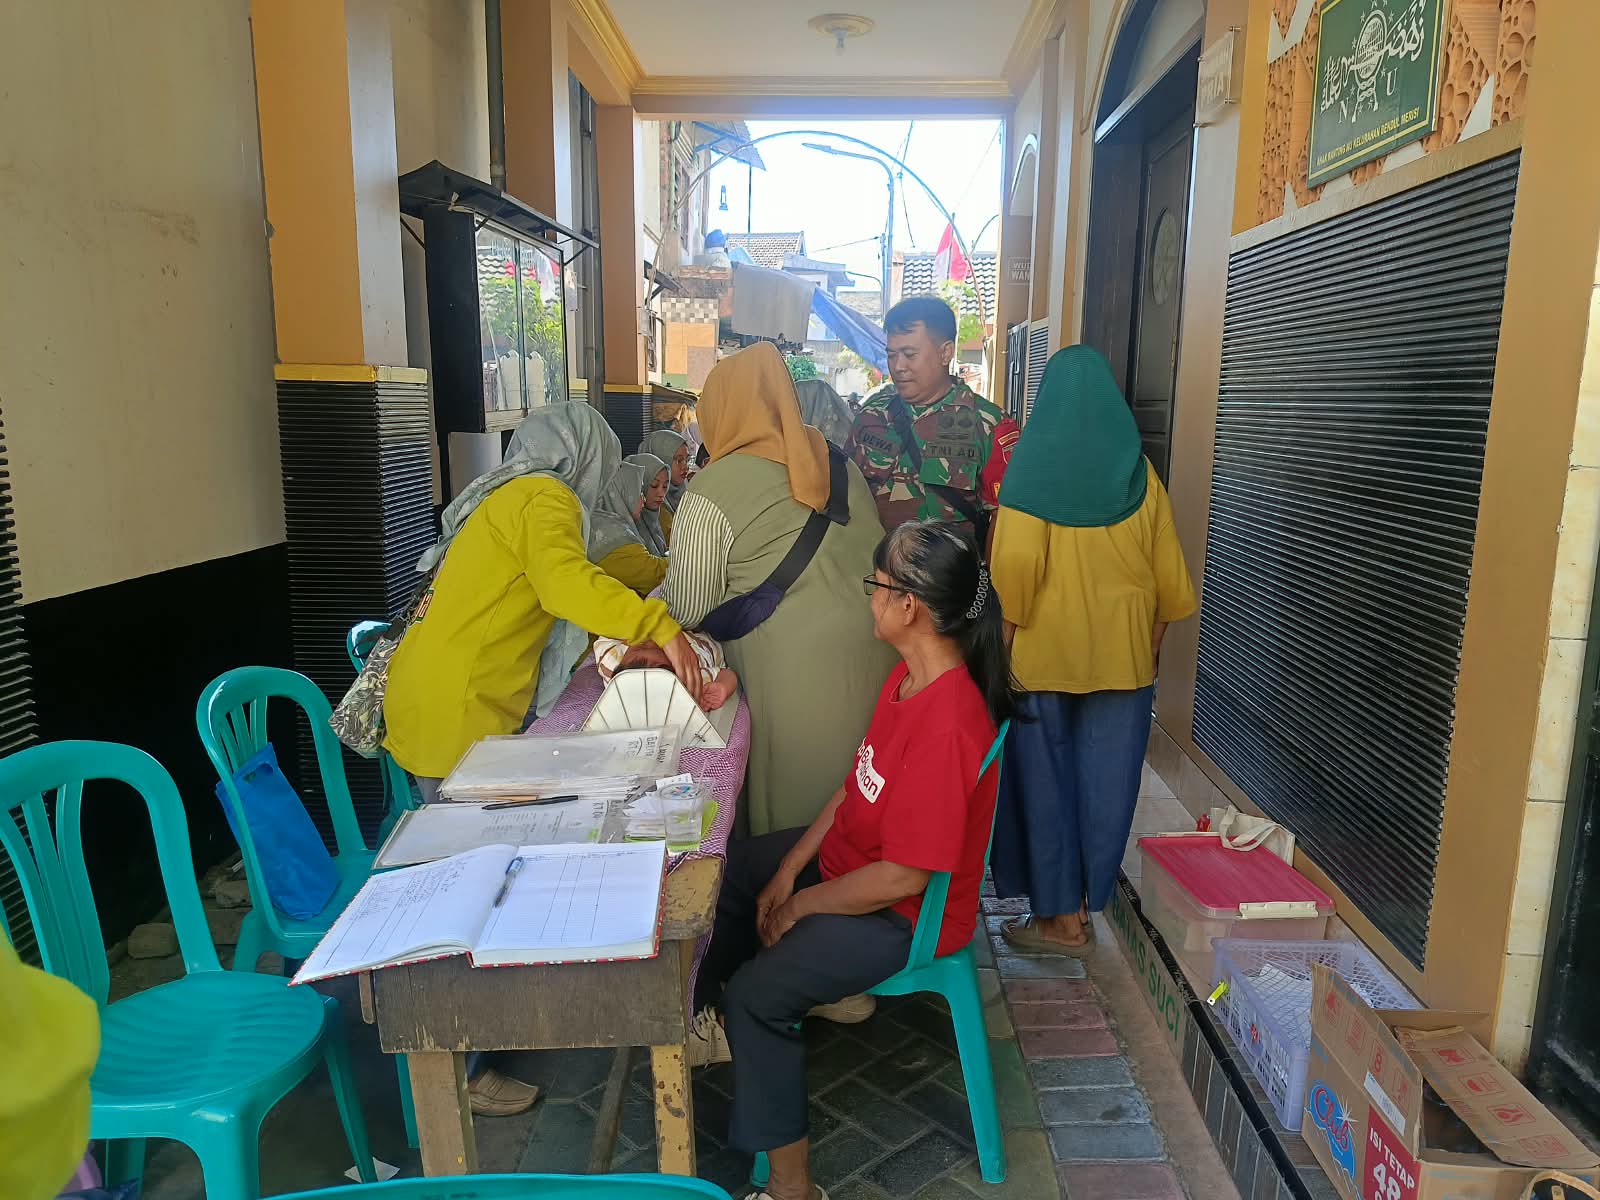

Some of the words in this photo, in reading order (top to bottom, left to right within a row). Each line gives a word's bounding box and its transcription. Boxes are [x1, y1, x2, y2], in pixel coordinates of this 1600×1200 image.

[1386, 67, 1398, 96] U
[931, 444, 952, 456] TNI
[1149, 961, 1181, 1041] SUCI
[1370, 1127, 1382, 1152] ISI
[1384, 1145, 1415, 1189] TETAP
